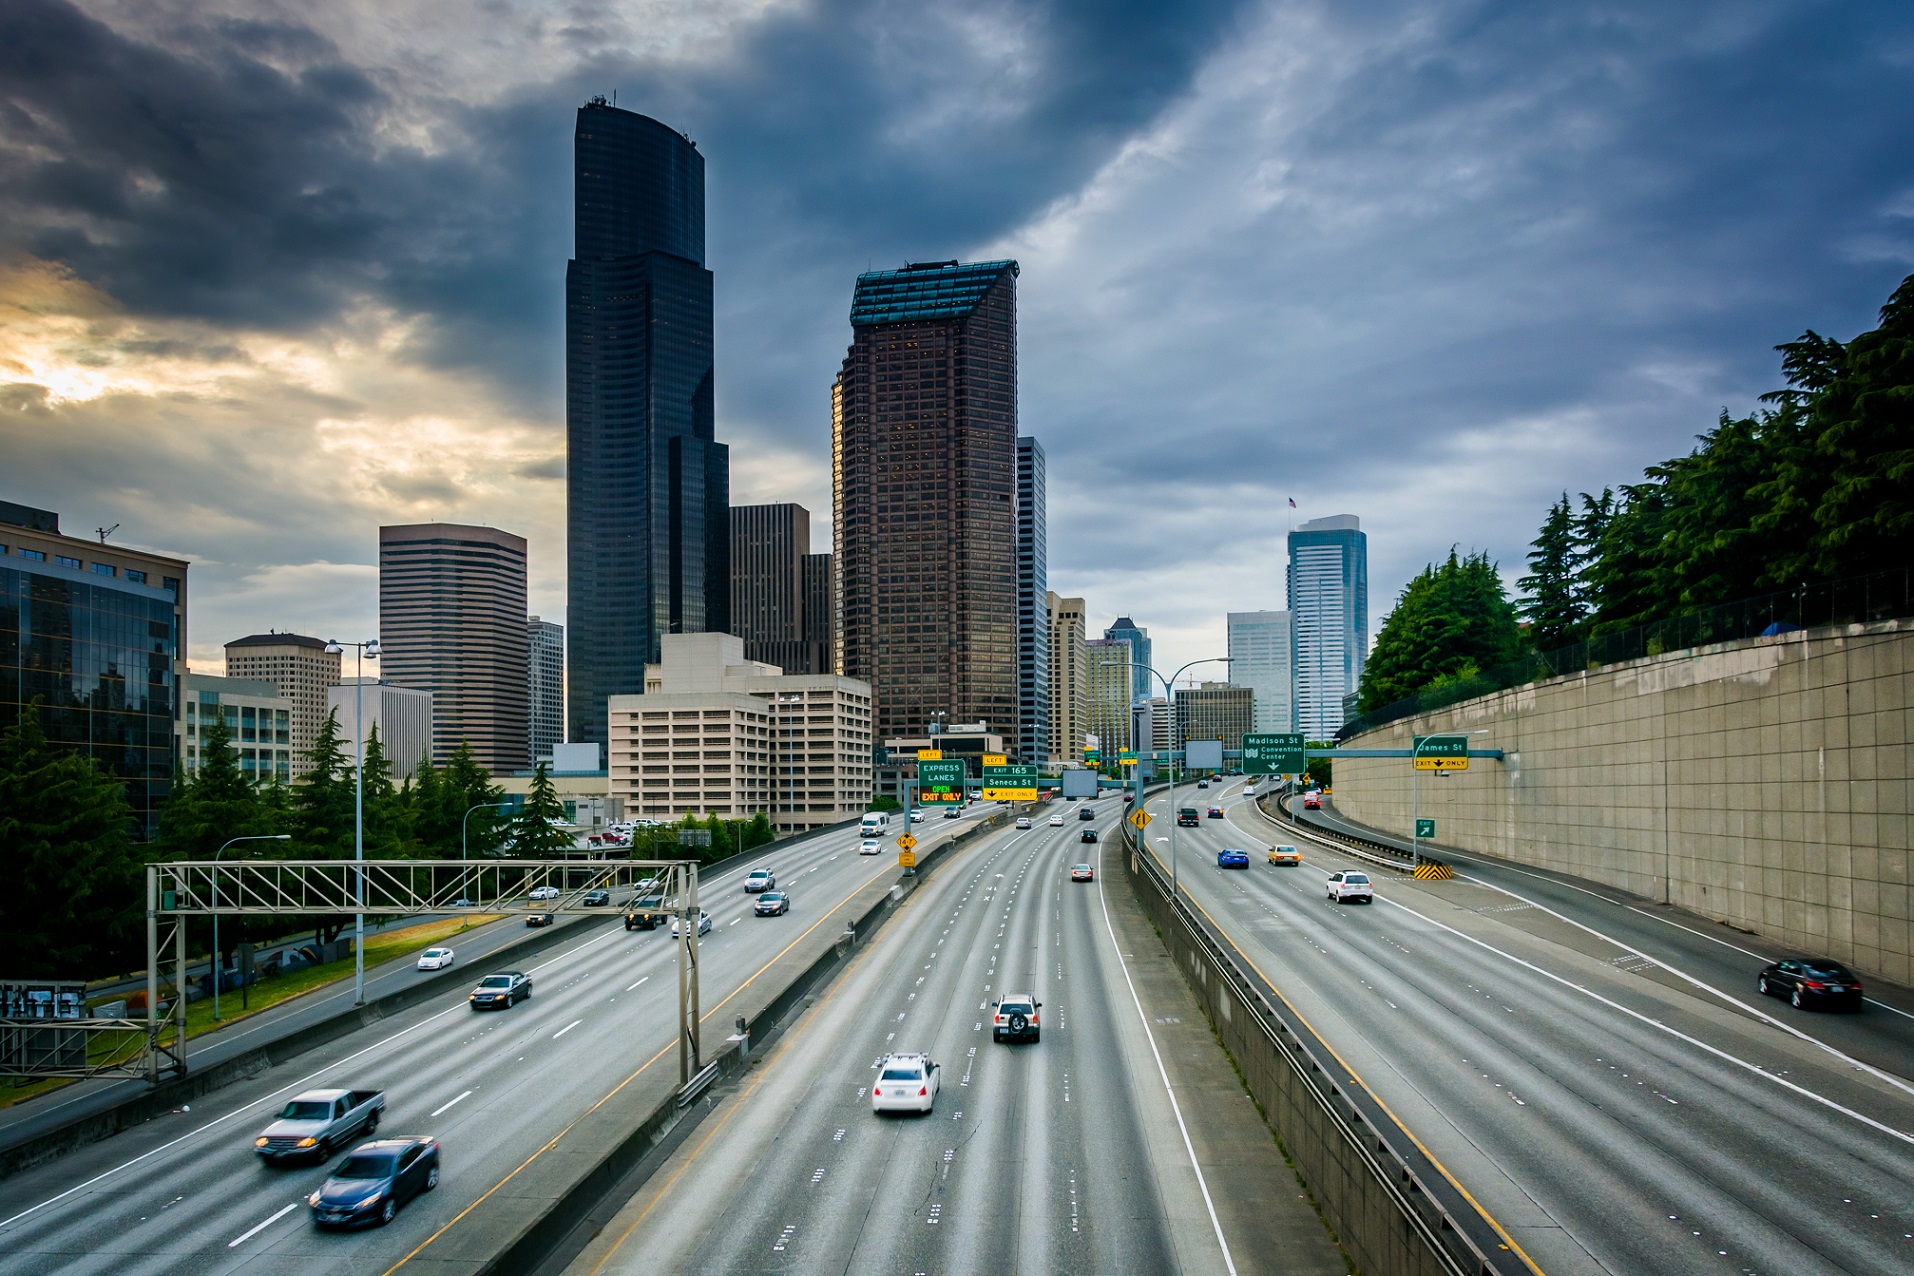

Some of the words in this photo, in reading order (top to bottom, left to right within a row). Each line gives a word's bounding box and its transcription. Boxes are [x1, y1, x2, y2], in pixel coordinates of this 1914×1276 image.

[1288, 736, 1298, 744] St
[1452, 743, 1463, 751] St
[923, 764, 960, 772] EXPRESS
[1011, 766, 1027, 775] 165
[989, 778, 1018, 786] Seneca
[1021, 778, 1032, 786] St
[932, 785, 951, 793] OPEN
[921, 792, 940, 801] EXIT
[941, 792, 962, 801] ONLY
